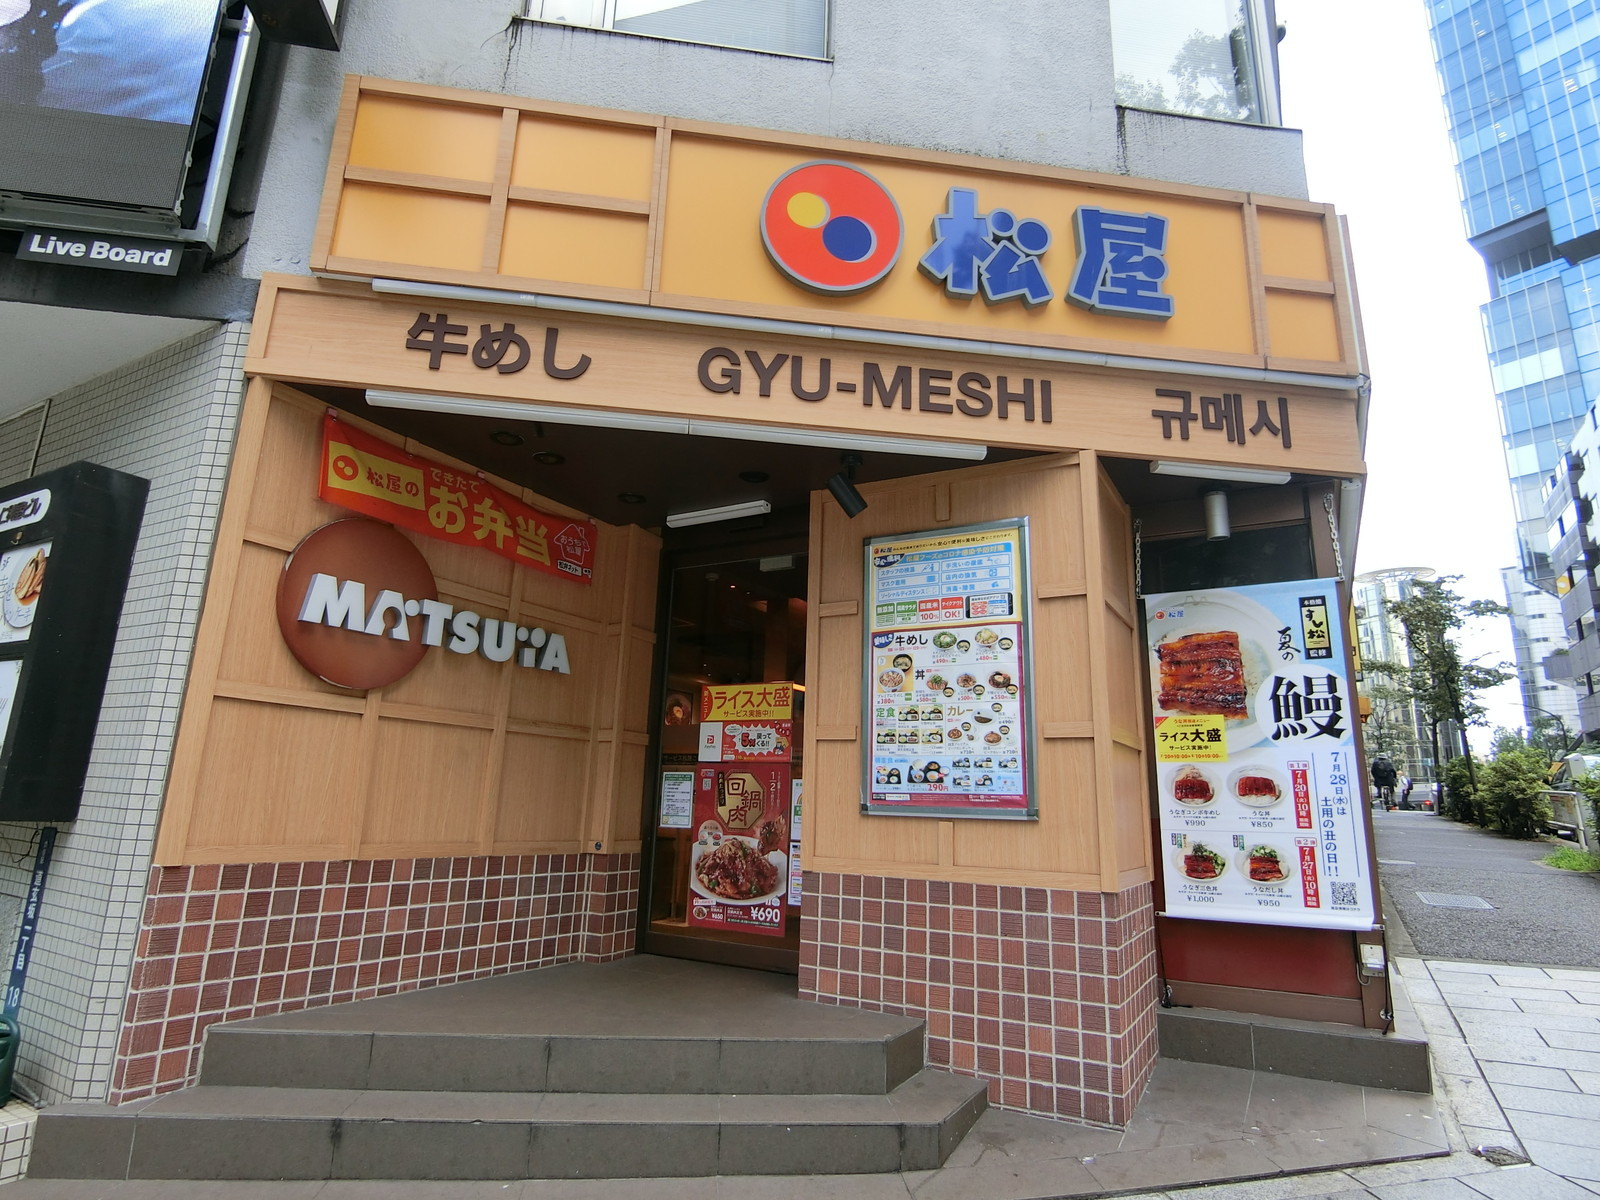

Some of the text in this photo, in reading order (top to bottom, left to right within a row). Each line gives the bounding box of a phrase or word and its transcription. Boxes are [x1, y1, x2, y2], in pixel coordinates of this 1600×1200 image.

[29, 234, 173, 267] Live Board
[917, 186, 1175, 322] 松屋
[405, 313, 592, 379] 牛めし
[699, 345, 1052, 423] GYU-MESHI
[1151, 387, 1292, 449] 규메시
[366, 467, 420, 498] 松屋の
[430, 467, 480, 494] できたて
[428, 484, 551, 566] お弁当
[298, 573, 571, 675] MATSUYA
[944, 610, 960, 619] OK!
[895, 634, 928, 646] 牛めし
[1277, 626, 1301, 661] 夏の
[915, 669, 925, 680] 丼
[714, 686, 791, 710] ライス大盛
[1268, 673, 1347, 741] 鰻
[723, 709, 774, 718] サービス実施中!!
[875, 707, 895, 718] 定食
[947, 706, 973, 716] カレー
[1159, 727, 1222, 743] ライス大盛
[1320, 797, 1340, 877] 土用の丑の日!!
[1187, 894, 1215, 903] ¥1,000
[1257, 899, 1281, 907] ¥950
[750, 906, 780, 923] ¥690
[7, 985, 20, 1008] 18
